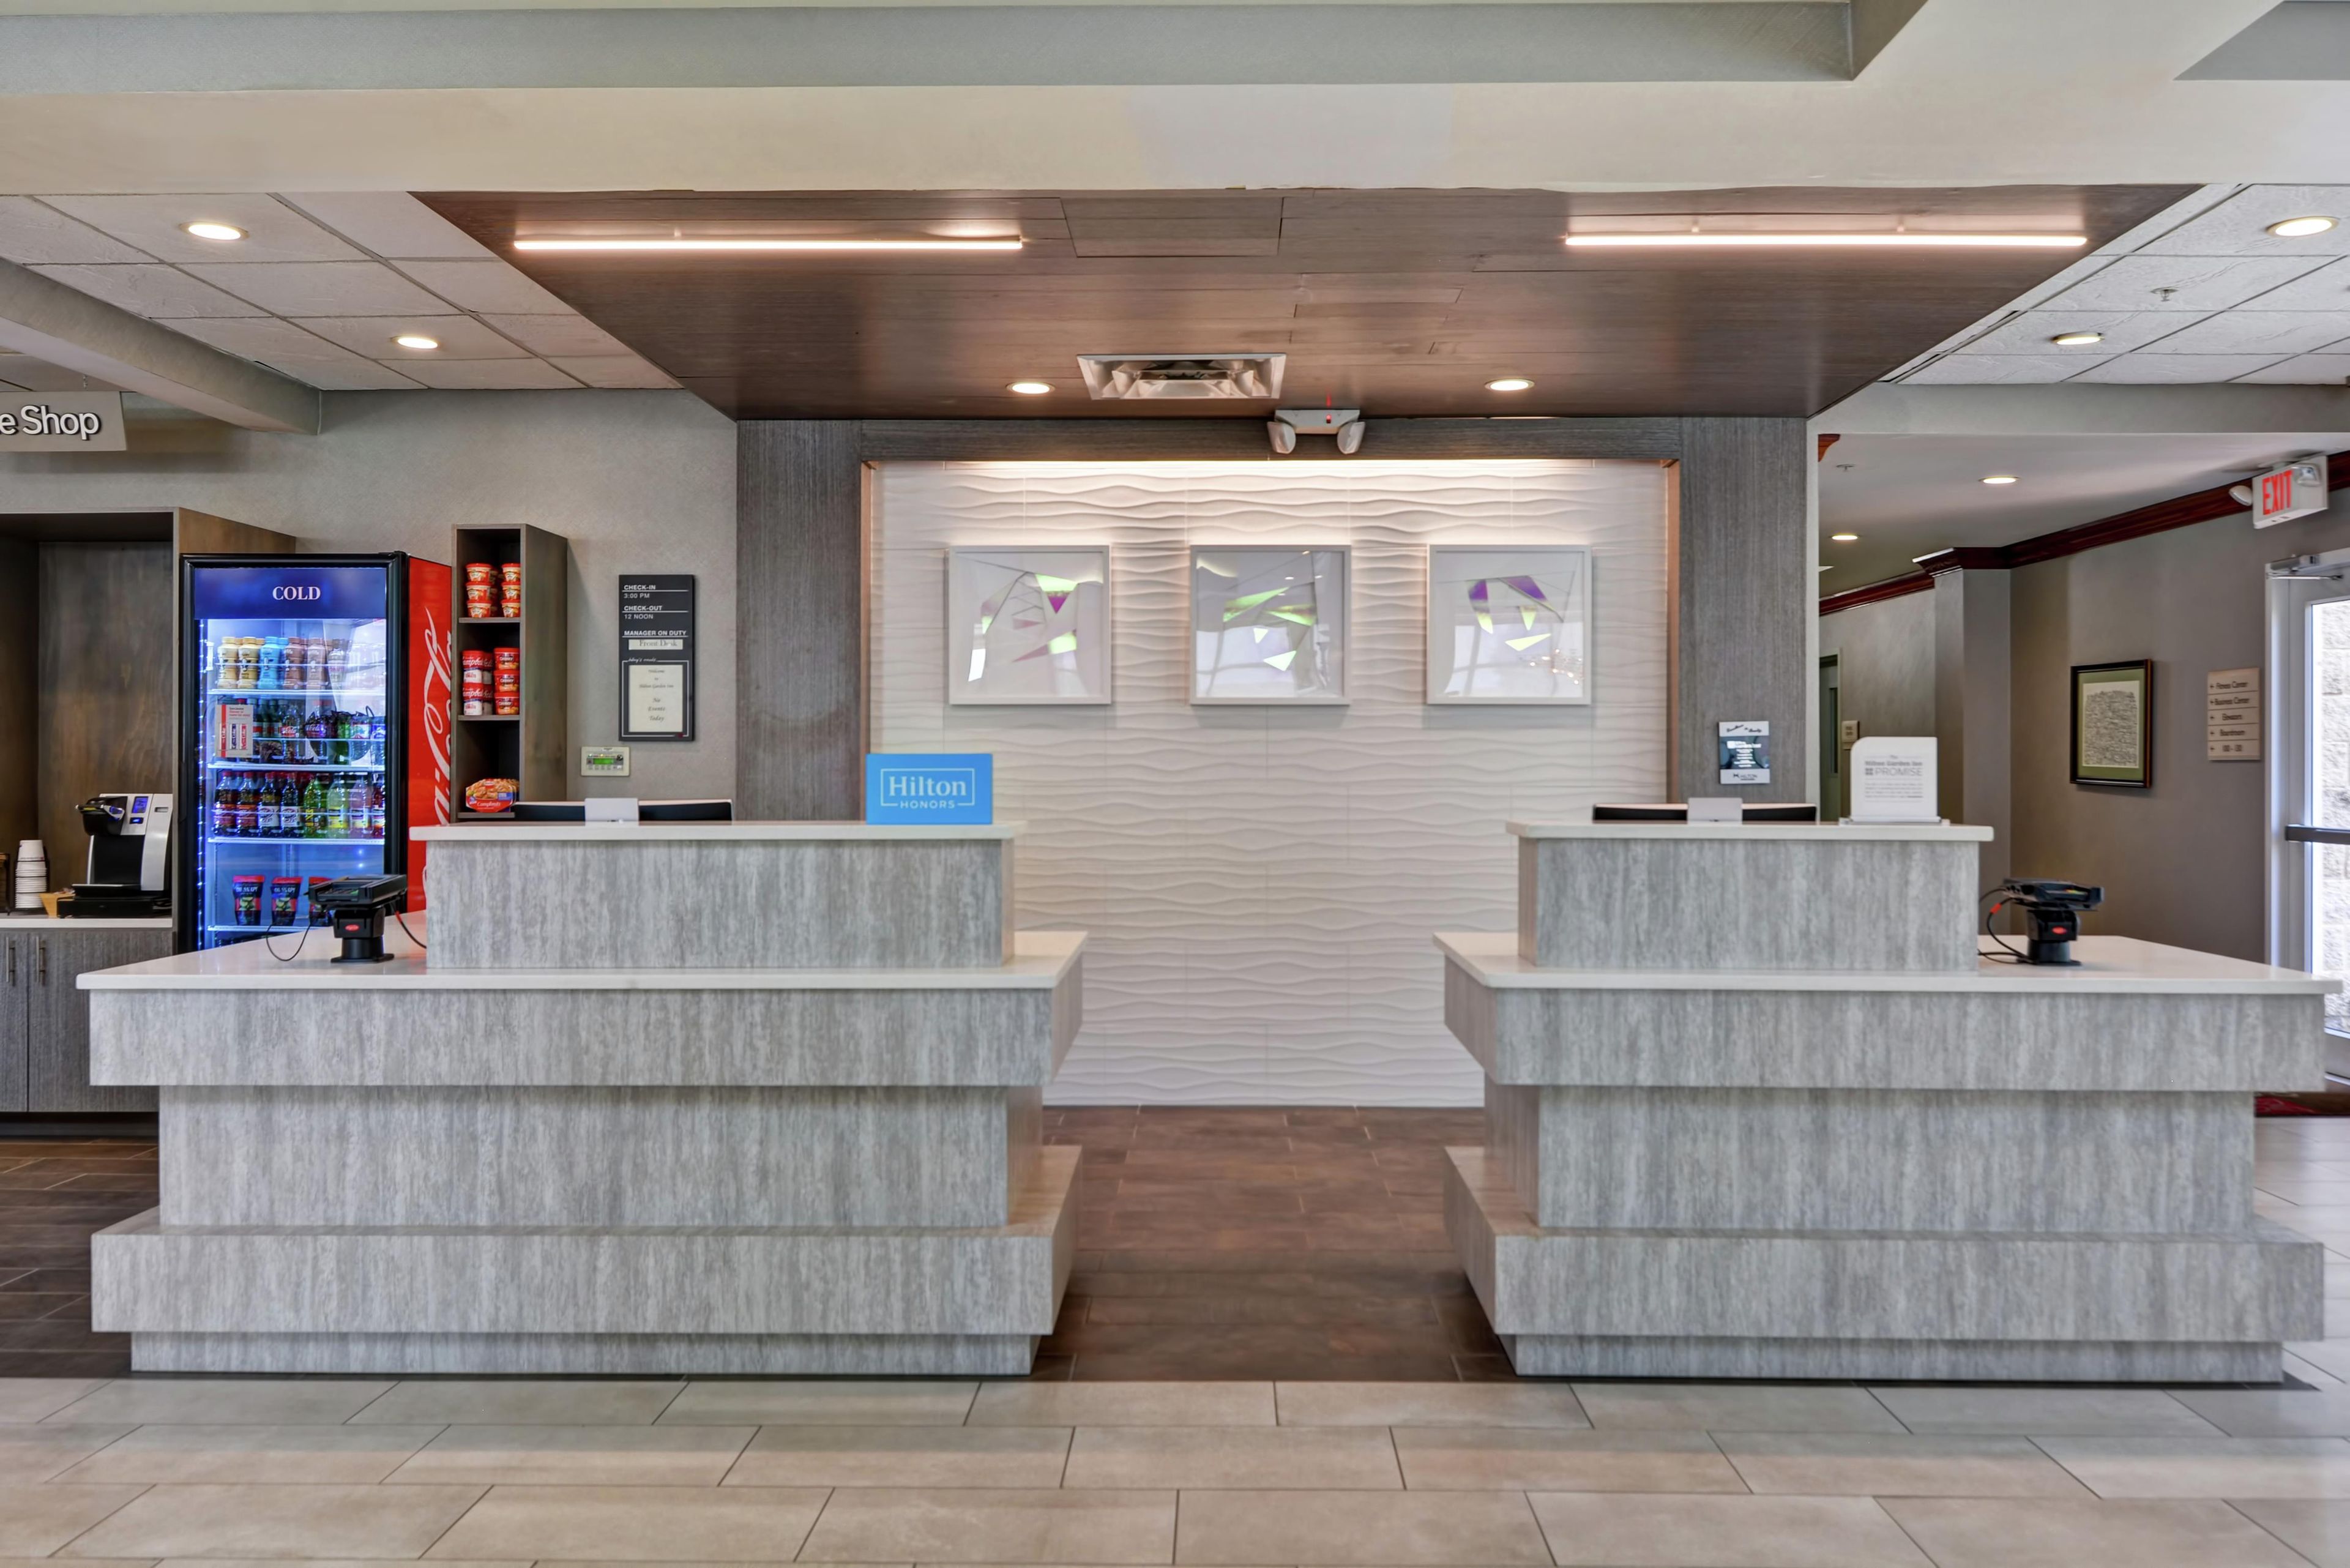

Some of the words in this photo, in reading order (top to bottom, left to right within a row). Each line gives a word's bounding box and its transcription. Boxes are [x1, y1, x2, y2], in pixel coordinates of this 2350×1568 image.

[20, 405, 100, 440] Shop
[2262, 469, 2292, 515] EXIT
[272, 586, 321, 601] COLD
[1875, 767, 1923, 776] PROMISE
[889, 775, 967, 796] Hilton
[900, 800, 955, 809] HONORS
